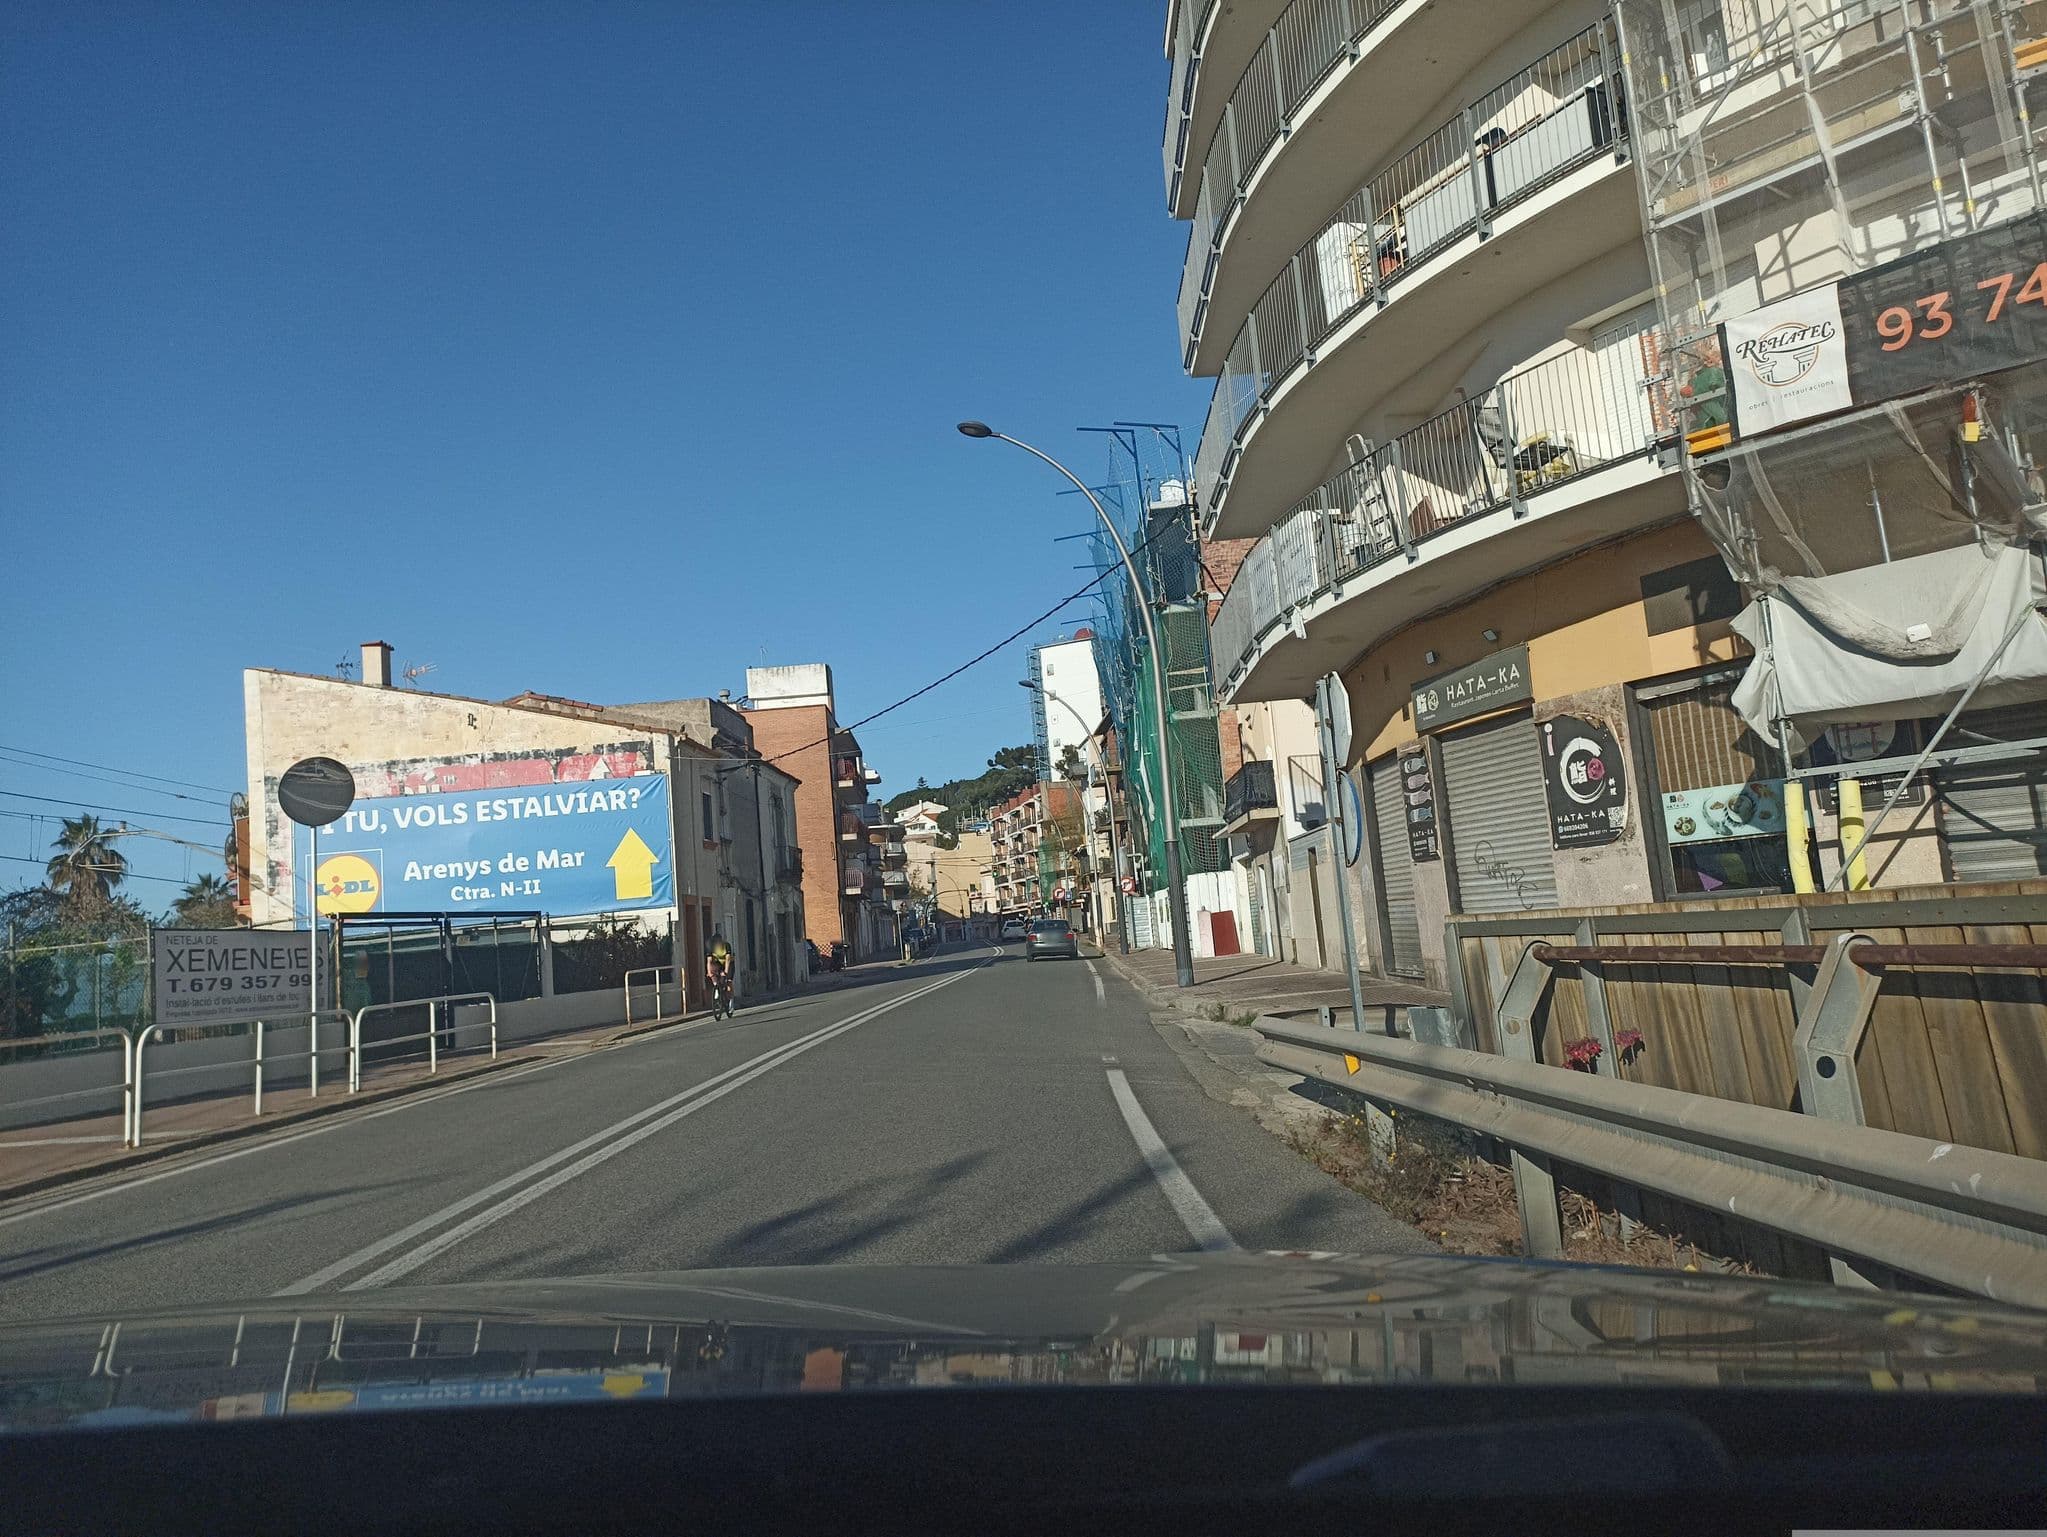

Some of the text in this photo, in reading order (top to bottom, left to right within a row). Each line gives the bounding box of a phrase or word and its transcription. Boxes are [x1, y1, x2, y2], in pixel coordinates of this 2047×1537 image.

[1876, 261, 2047, 352] 93 74
[1736, 320, 1836, 363] REHATEC
[1446, 663, 1520, 701] HATA-KA
[344, 810, 387, 834] TU,
[393, 802, 468, 829] VOLS
[476, 787, 641, 822] ESTALVIAR?
[1557, 809, 1605, 824] HATA-KA
[403, 849, 585, 882] Arenys de Mar
[450, 879, 541, 901] Ctra. N-II
[166, 935, 218, 946] NETEJA DE
[166, 948, 323, 973] XEMENEIES
[167, 976, 233, 993] T.679
[241, 975, 281, 989] 357
